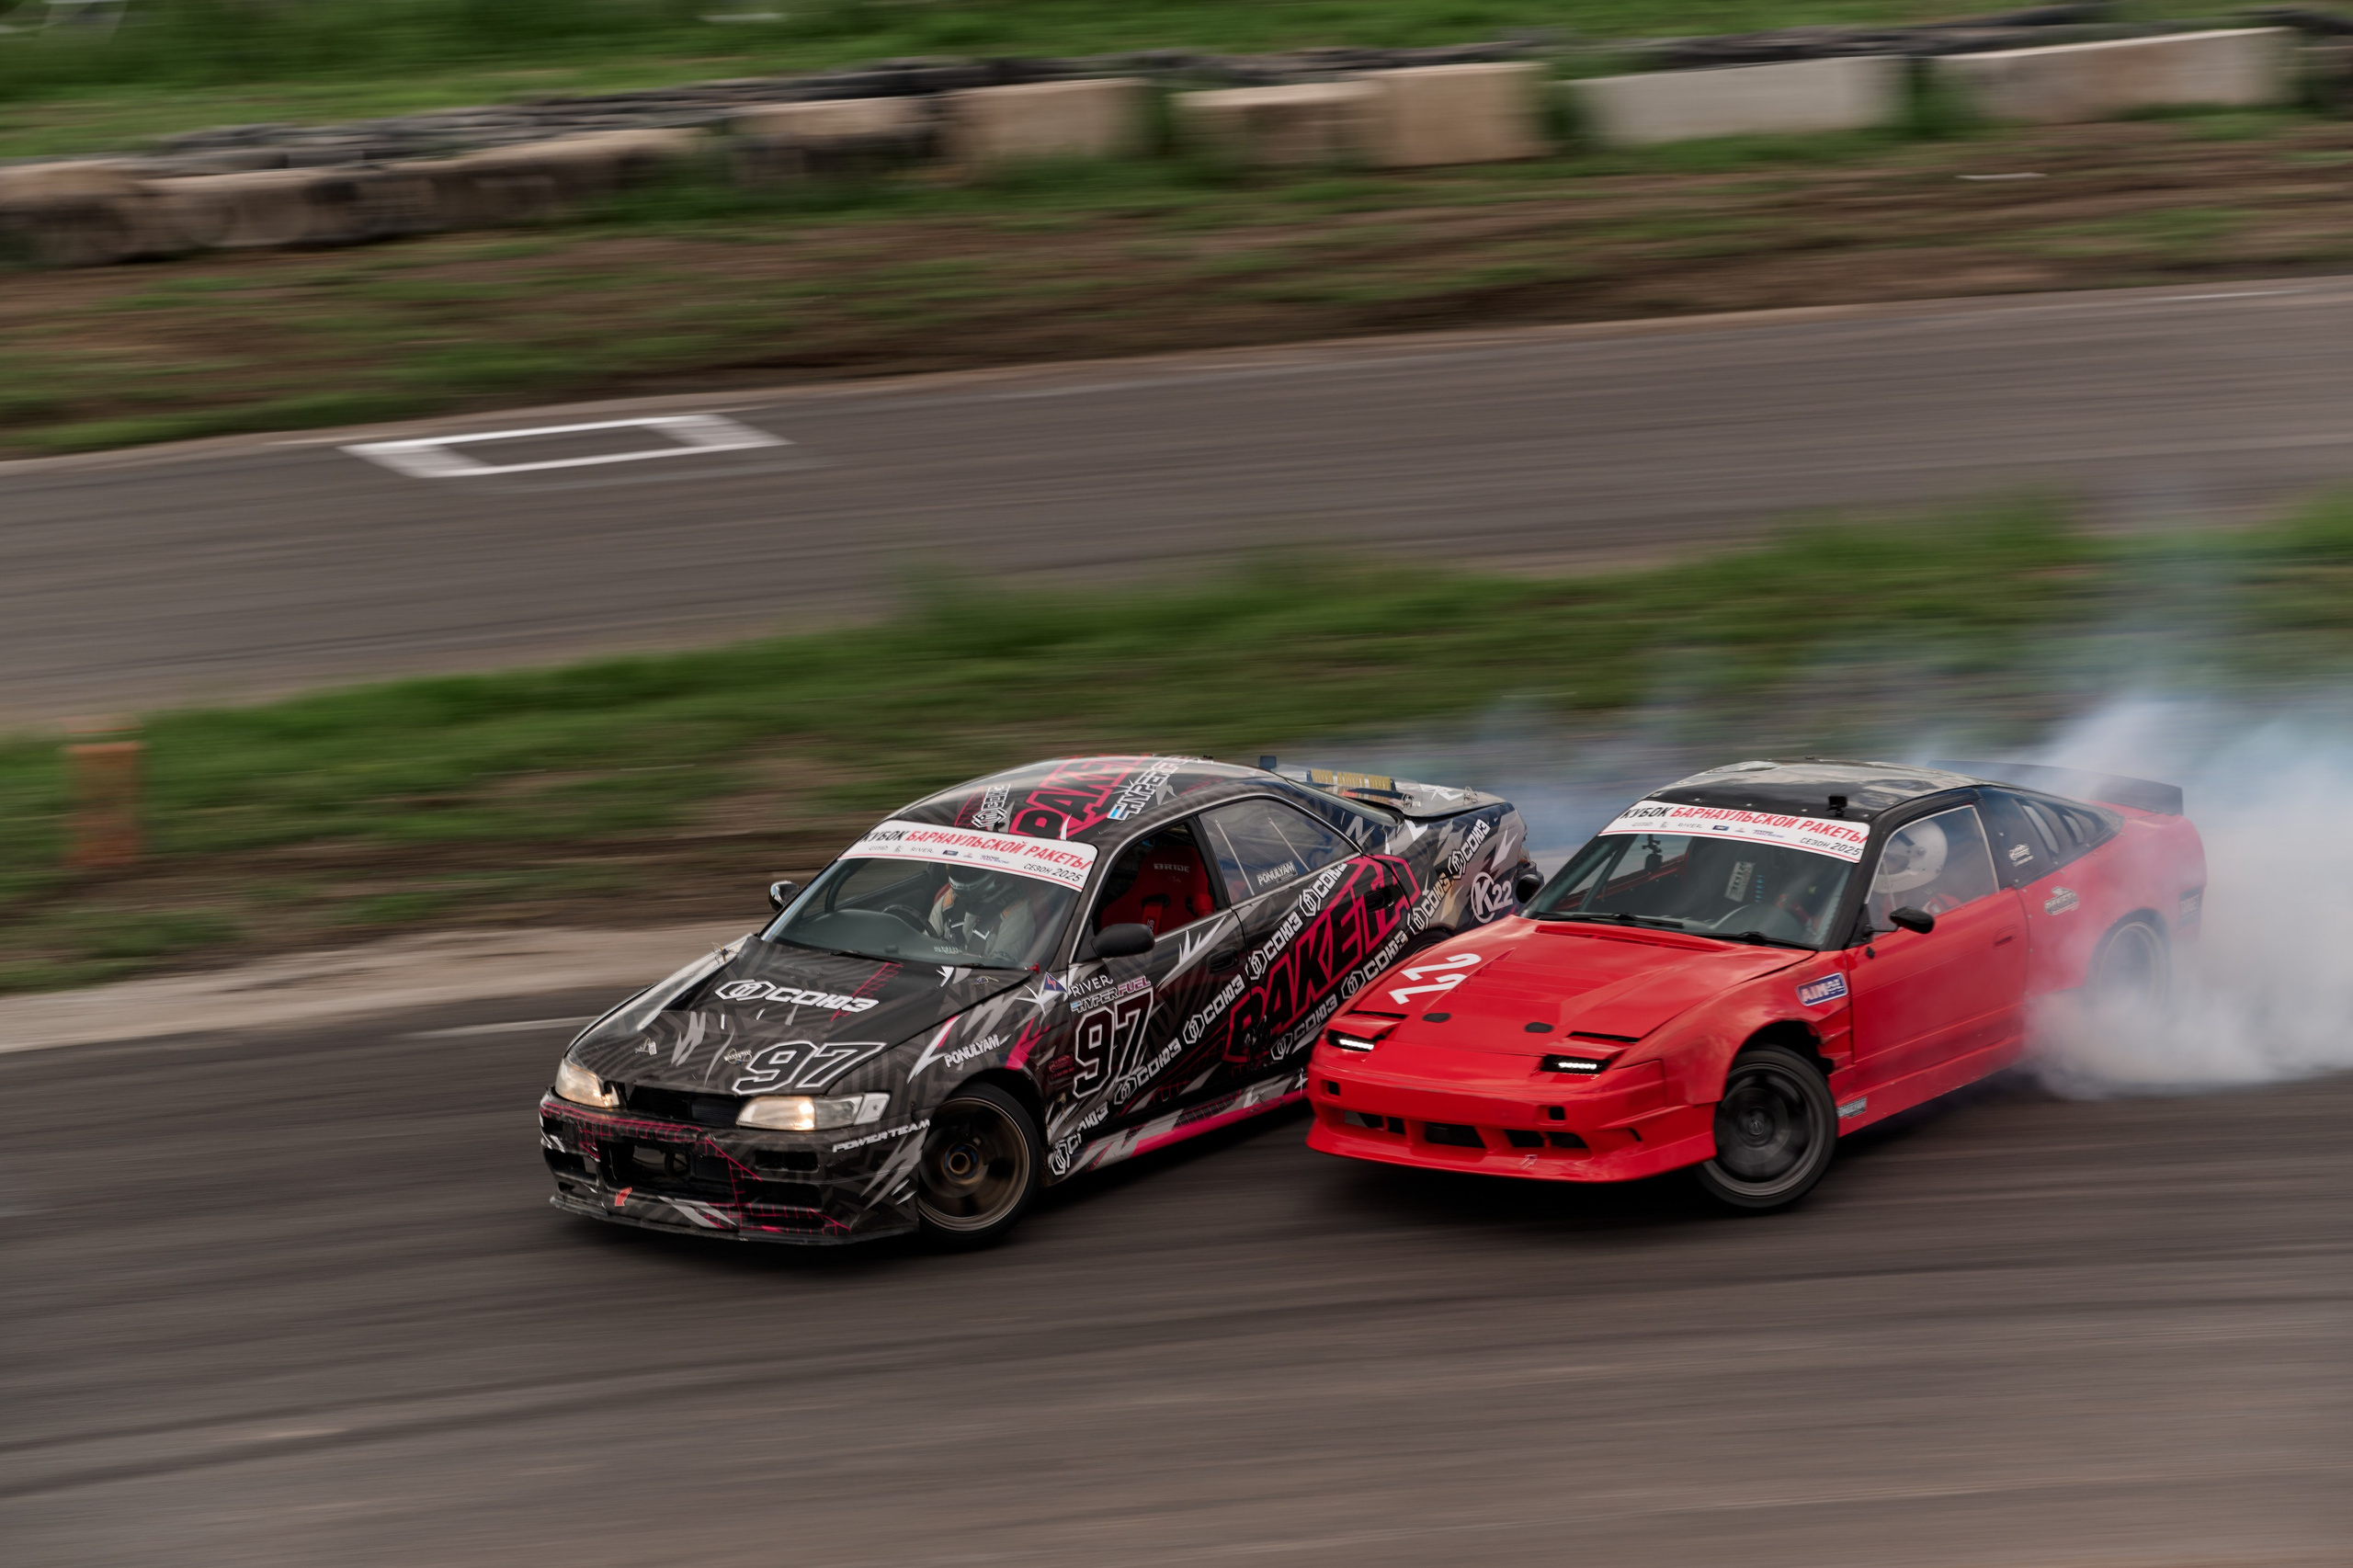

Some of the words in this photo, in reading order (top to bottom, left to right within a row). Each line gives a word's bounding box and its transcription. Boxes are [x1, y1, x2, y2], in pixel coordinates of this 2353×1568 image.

[1461, 819, 1491, 862] СОЮЗ
[1620, 807, 1673, 819] КУБОК
[1670, 807, 1801, 828] БАРНАУЛЬСКОЙ
[1798, 820, 1869, 844] РАКЕТЫ
[859, 831, 910, 843] КУБОК
[905, 830, 1028, 855] БАРНАУЛЬСКОЙ
[1023, 846, 1094, 870] РАКЕТЫ
[1799, 837, 1831, 848] СЕЗОН
[1830, 842, 1864, 856] 2025
[1023, 863, 1051, 875] СЕЗОН
[1052, 868, 1085, 882] 2025
[1153, 863, 1190, 873] BRIDE
[1256, 860, 1295, 886] PONULYAM
[1262, 911, 1303, 961] СОЮЗ
[766, 986, 880, 1013] СОЮЗ
[1071, 974, 1114, 997] RIVER
[1202, 973, 1245, 1025] СОЮЗ
[1293, 994, 1339, 1041] СОЮЗ
[944, 1034, 1001, 1068] PONULYAM
[1073, 986, 1154, 1099] 97
[732, 1040, 888, 1096] 97
[1137, 1038, 1182, 1086] СОЮЗ
